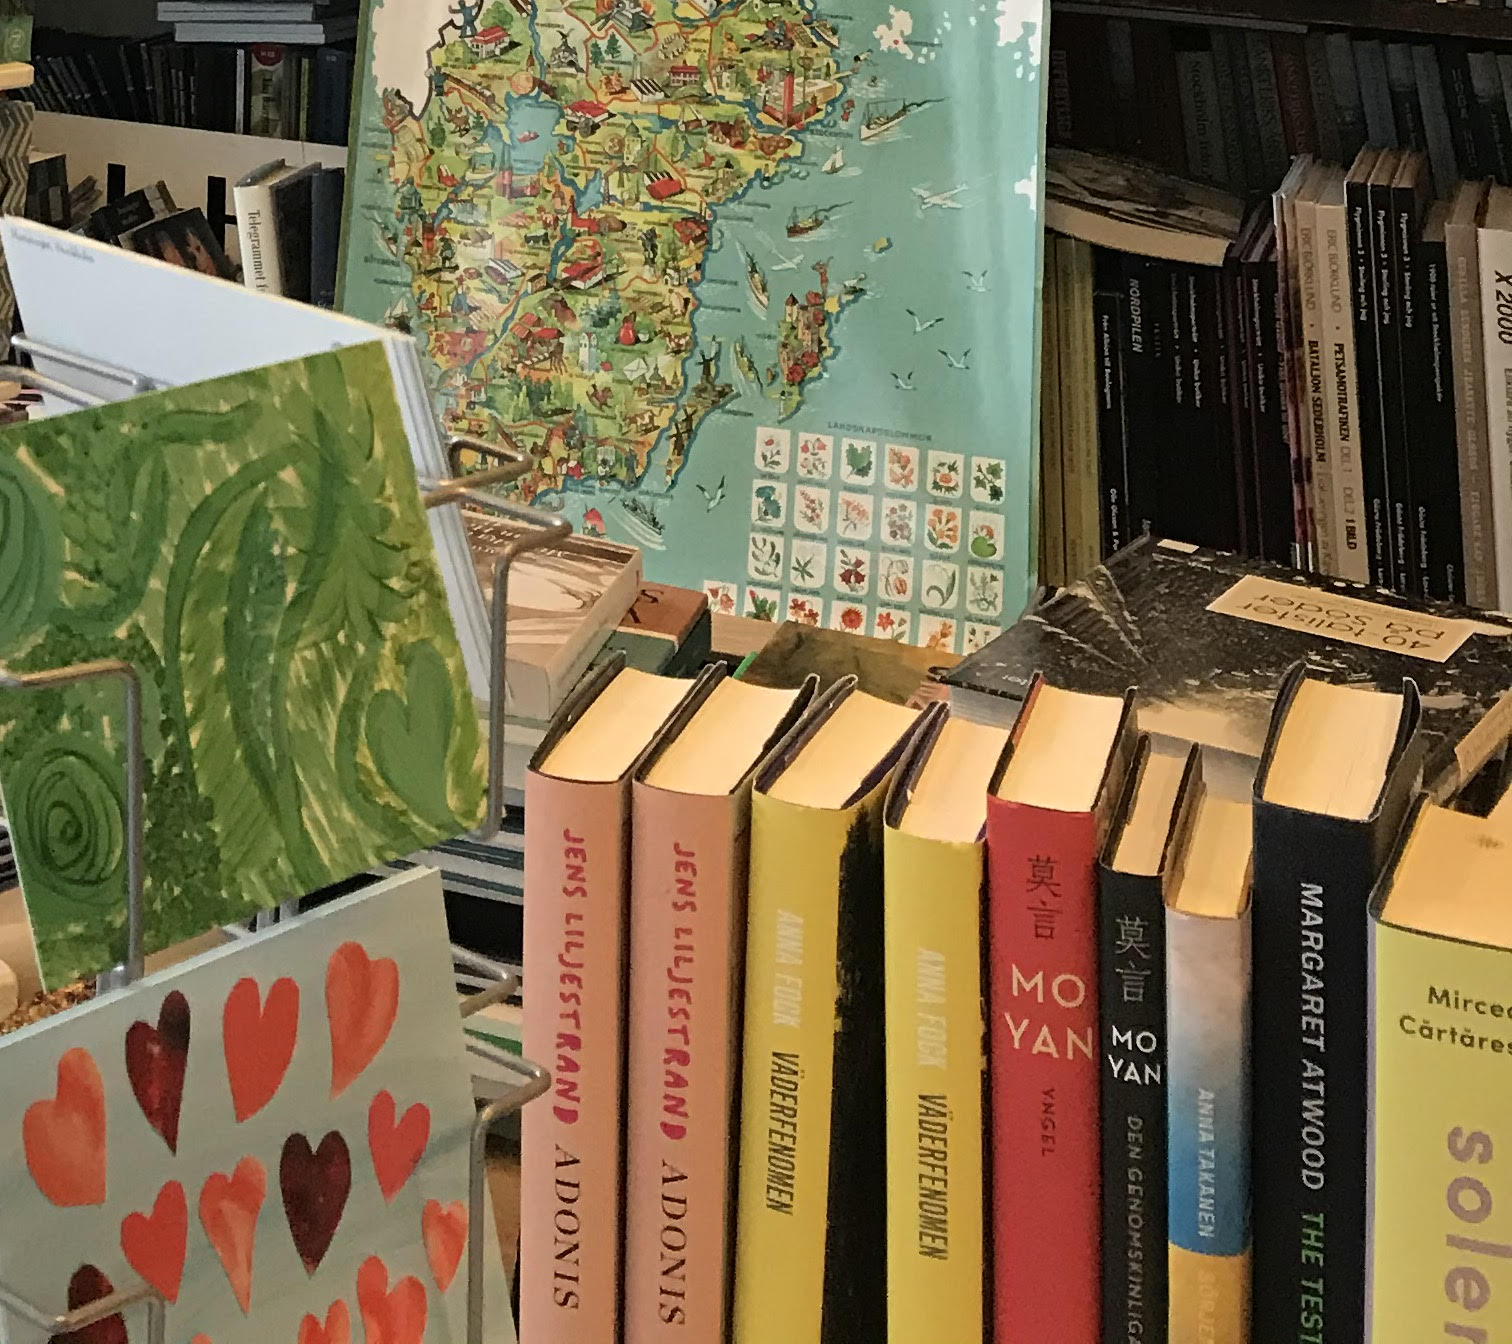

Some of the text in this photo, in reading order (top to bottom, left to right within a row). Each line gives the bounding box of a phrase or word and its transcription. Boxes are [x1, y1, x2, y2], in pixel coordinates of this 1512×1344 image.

[247, 209, 267, 280] Telegrammet
[1325, 229, 1339, 250] ERIC
[1128, 277, 1144, 353] NORDPILEN
[1327, 252, 1342, 312] BJÖRKLUND
[1494, 269, 1512, 345] X 2000
[1300, 227, 1314, 248] ERIC
[1311, 396, 1327, 462] SEDERHOLM
[1333, 342, 1351, 442] PETSAMOTRAFIKEN
[1345, 525, 1358, 550] BILD
[1025, 852, 1064, 941] 莫言
[1011, 963, 1087, 1010] MO
[1114, 915, 1153, 1004] 莫言
[1299, 879, 1326, 1053] MARGARET
[551, 828, 589, 1312] JENS LILJESTRAND ADONIS
[764, 907, 806, 1218] ANNA FOCK VÄDERFENOMEN
[1003, 1011, 1095, 1062] YAN
[1107, 1054, 1162, 1087] YAN
[1110, 1023, 1158, 1055] MO
[659, 841, 699, 1327] JENS LILJESTRAND ADONIS
[914, 945, 955, 1262] ANNA FOCK VÄDERFENOMEN
[1040, 1086, 1057, 1159] YNGEL
[1127, 1115, 1144, 1161] DEN
[1300, 1059, 1326, 1191] ATWOOD
[1197, 1087, 1217, 1239] ANNA TAKANEN
[1300, 1212, 1326, 1267] THE
